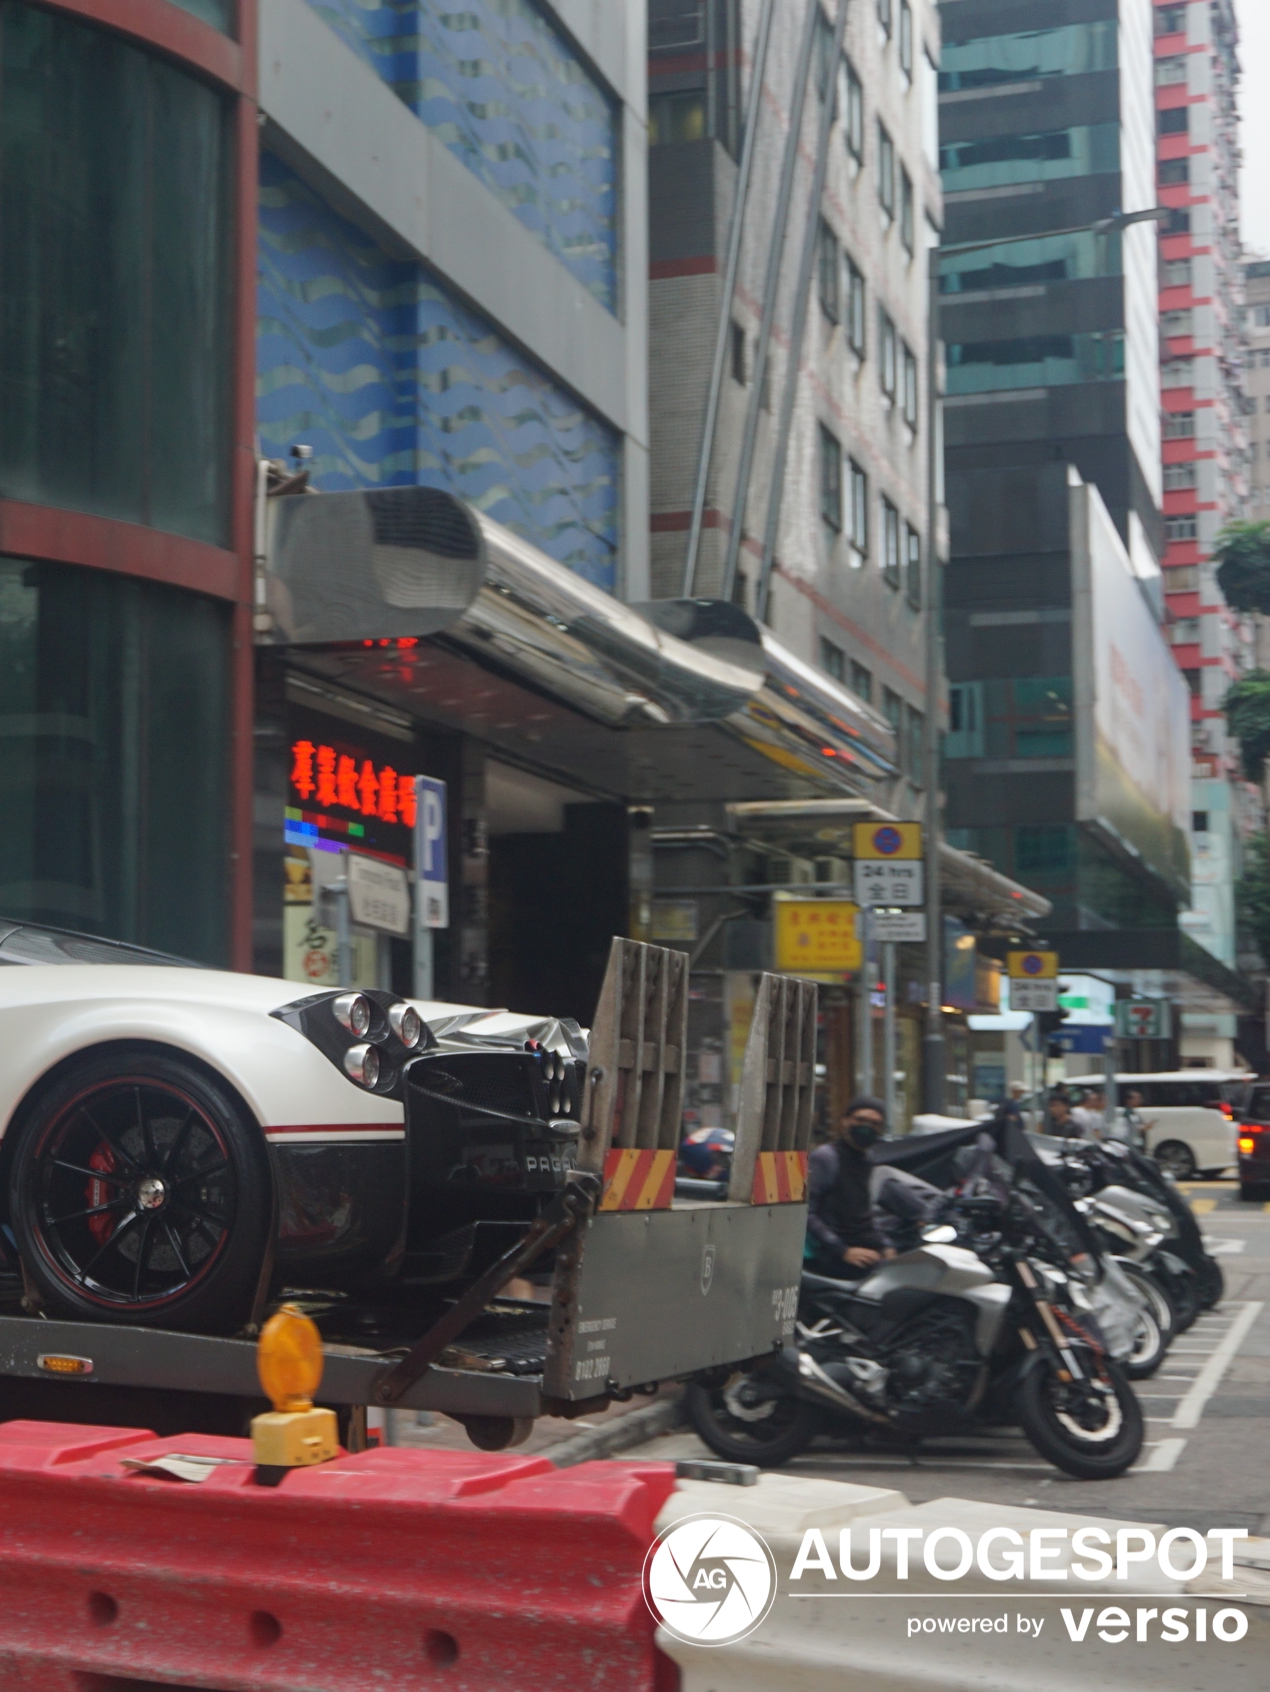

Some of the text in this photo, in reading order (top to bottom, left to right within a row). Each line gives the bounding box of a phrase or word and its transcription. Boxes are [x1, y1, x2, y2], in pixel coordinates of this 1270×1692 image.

[423, 789, 442, 871] P
[862, 865, 914, 878] 24 hrs
[868, 883, 910, 900] 全日
[526, 1156, 577, 1172] PAGAN
